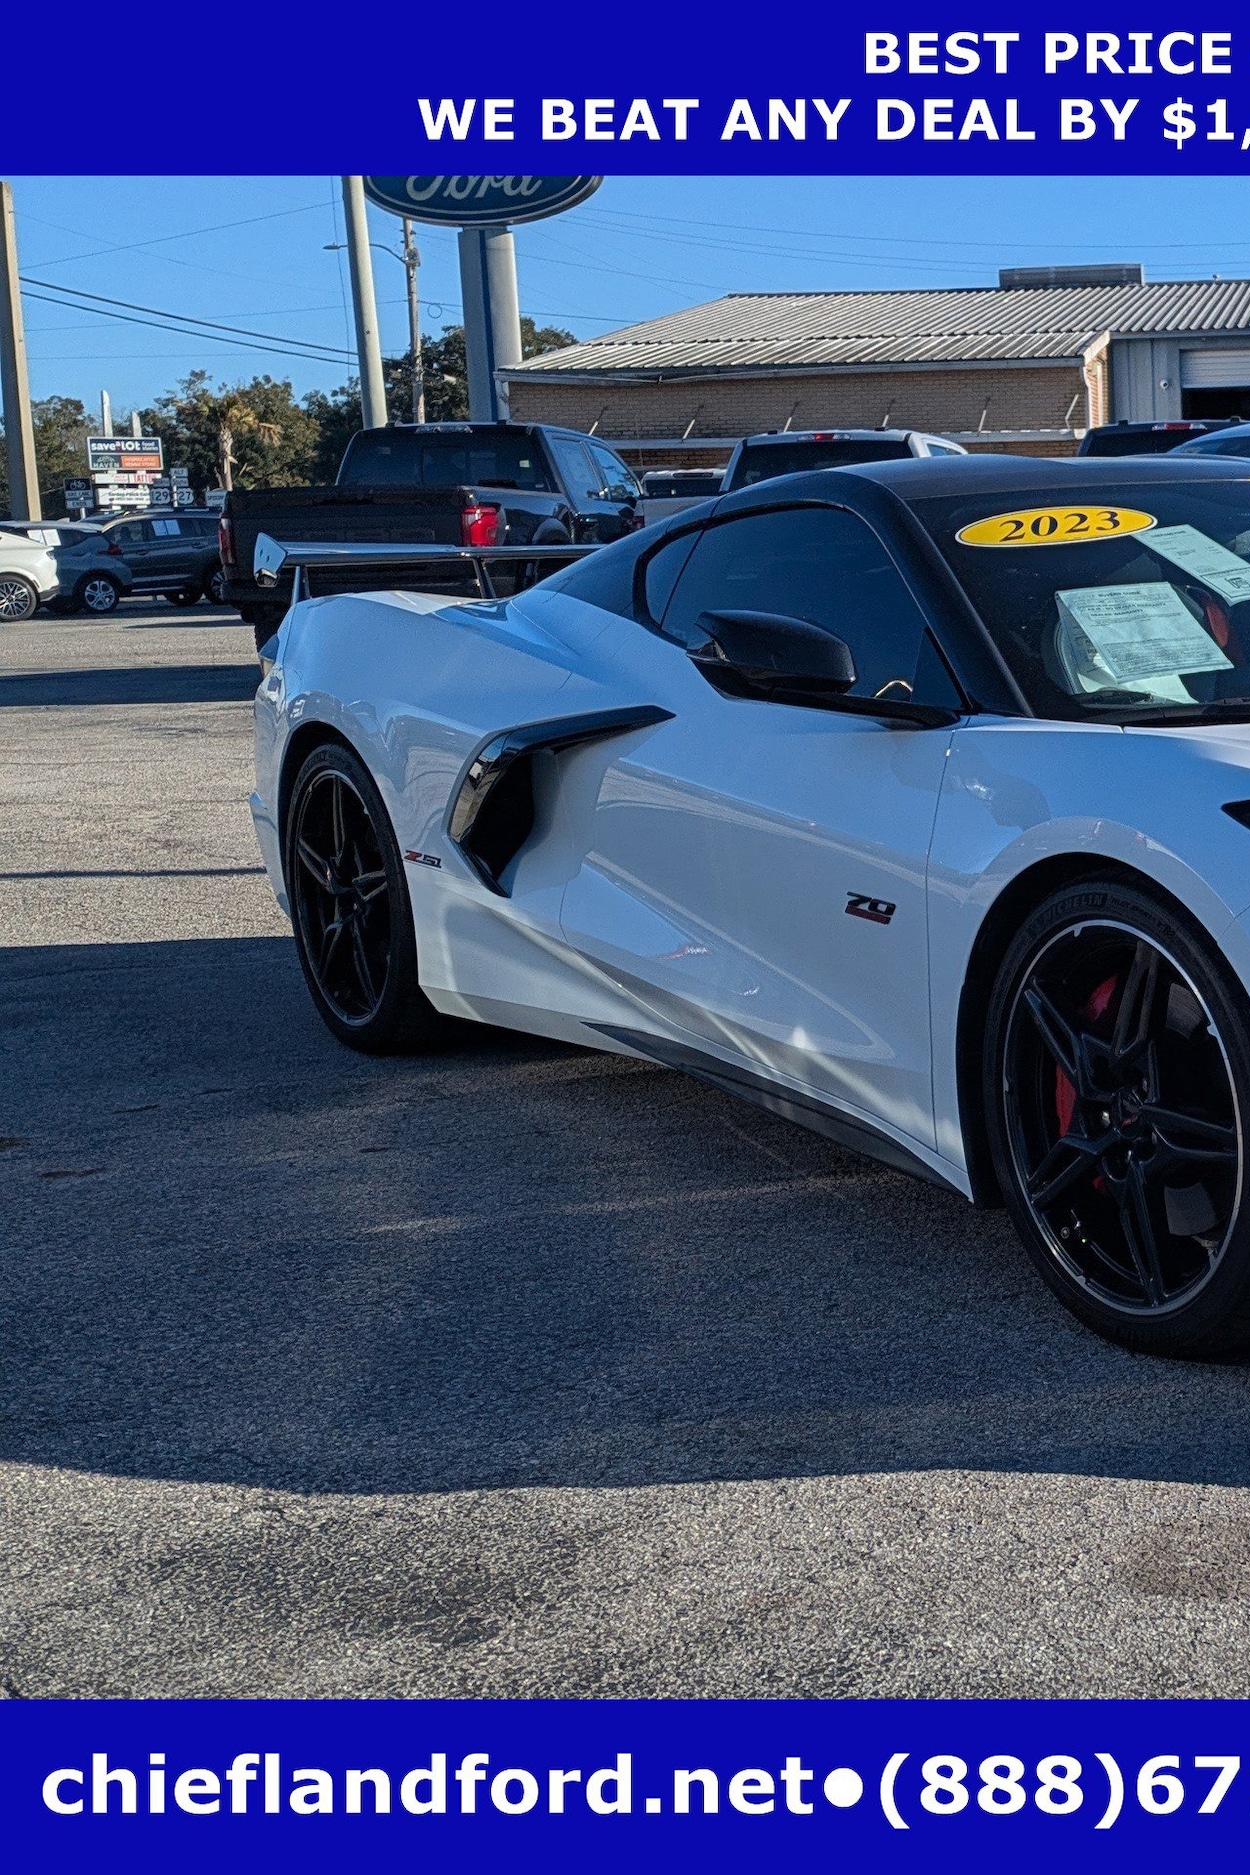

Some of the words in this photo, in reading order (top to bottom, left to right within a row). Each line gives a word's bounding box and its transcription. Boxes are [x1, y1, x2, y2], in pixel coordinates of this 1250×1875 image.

[91, 441, 115, 451] save
[179, 491, 190, 501] 27
[1000, 511, 1121, 542] 2023
[403, 849, 442, 869] Z51
[846, 891, 896, 917] 70
